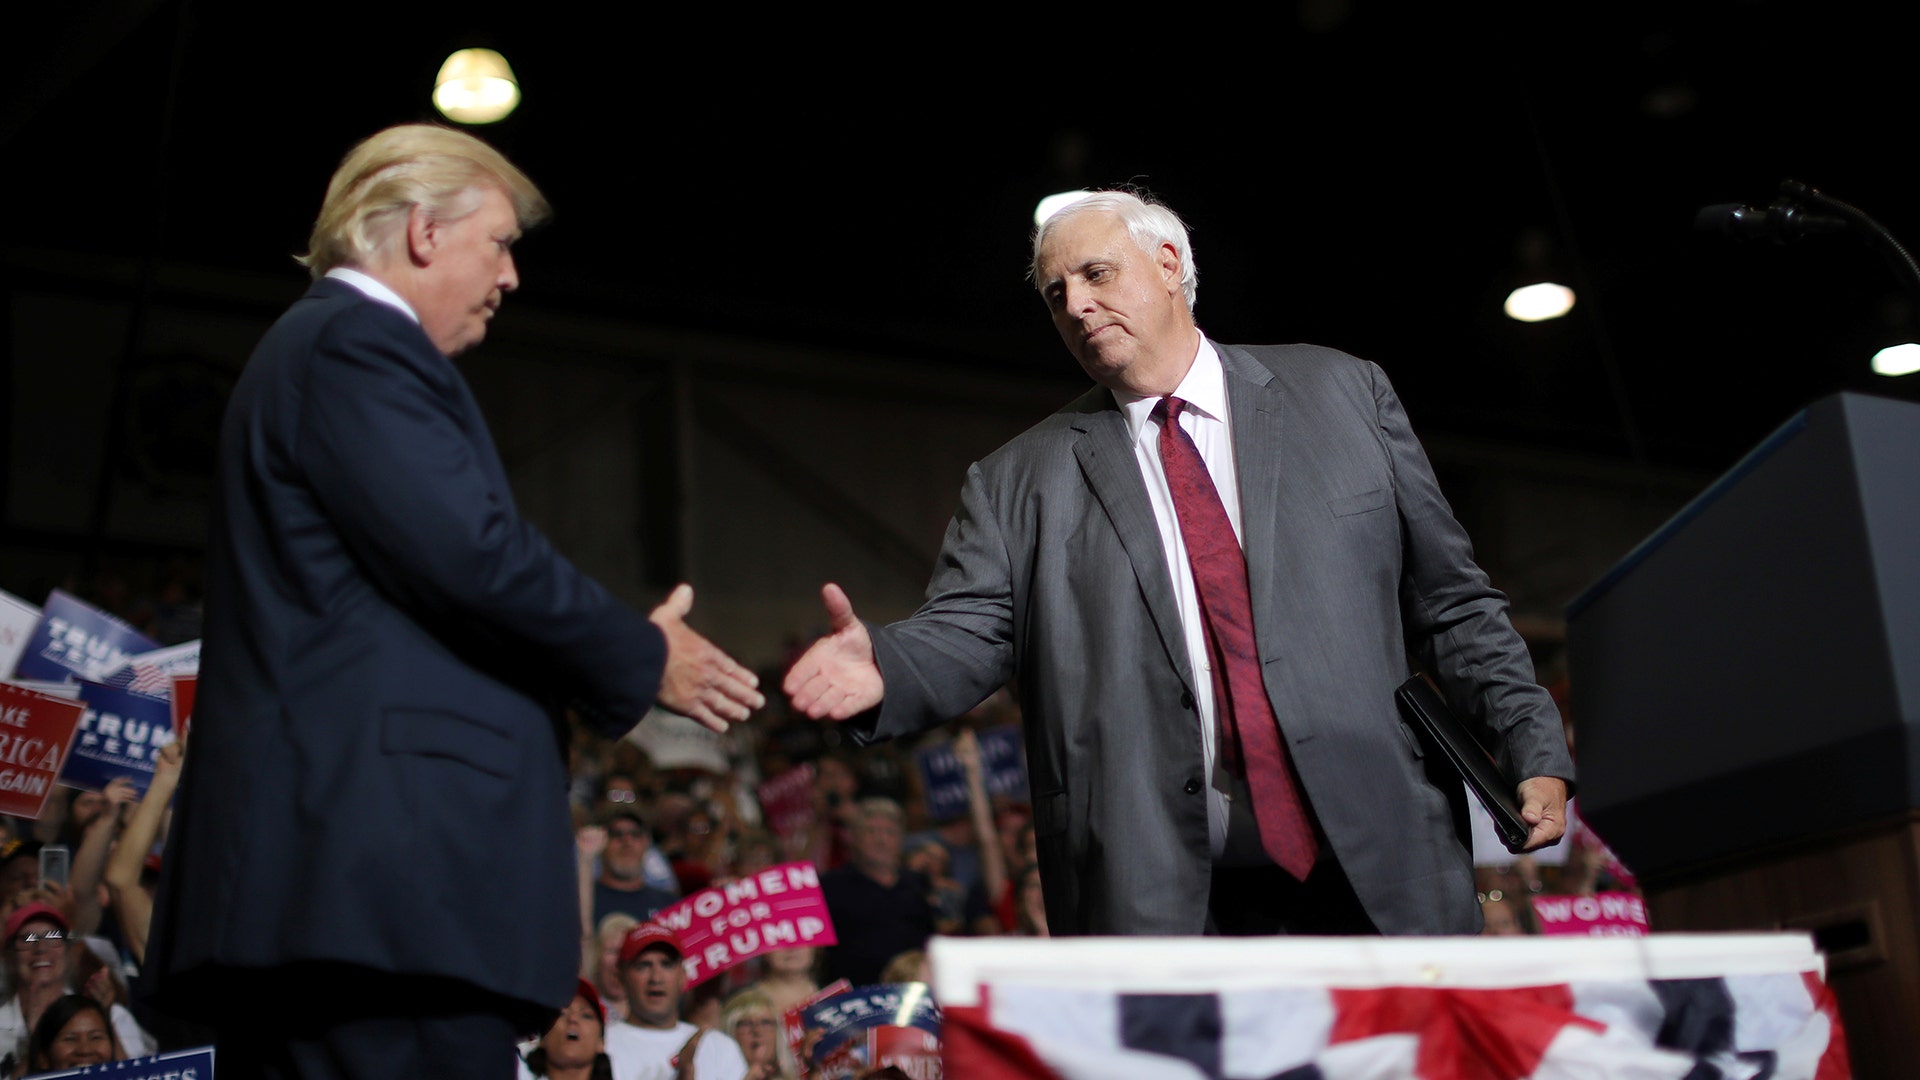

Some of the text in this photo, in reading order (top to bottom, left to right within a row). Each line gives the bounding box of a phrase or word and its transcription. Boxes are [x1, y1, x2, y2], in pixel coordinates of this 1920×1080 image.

[654, 864, 820, 930] WOMEN
[710, 902, 772, 937] FOR
[682, 916, 825, 980] TRUMP
